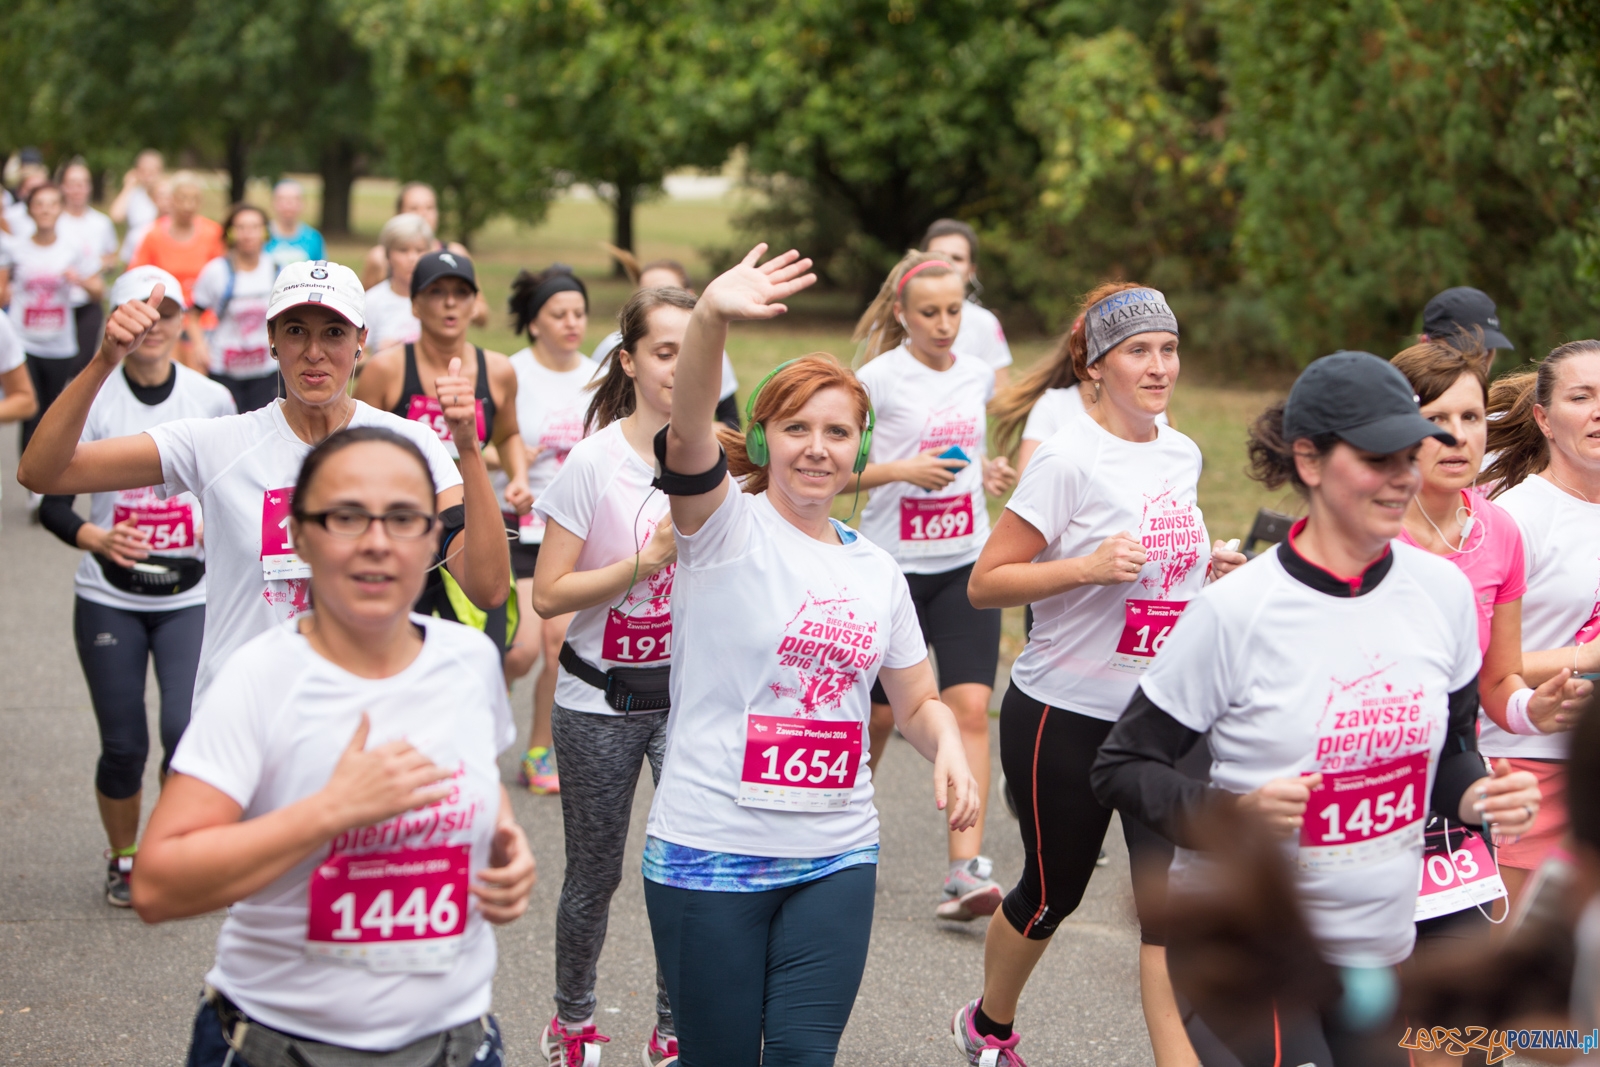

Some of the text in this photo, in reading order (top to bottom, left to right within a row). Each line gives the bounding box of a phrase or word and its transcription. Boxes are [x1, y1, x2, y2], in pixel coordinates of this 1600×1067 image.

[1099, 291, 1155, 317] LESZNO
[910, 511, 969, 539] 1699
[1150, 514, 1195, 531] zawsze
[1146, 549, 1168, 562] 2016
[799, 620, 873, 650] zawsze
[826, 617, 866, 633] BIEG KOBIET
[779, 653, 813, 670] 2016
[1334, 704, 1420, 730] zawsze
[776, 726, 803, 737] Zawsze
[832, 731, 848, 740] 2016
[760, 745, 850, 784] 1654
[1319, 783, 1416, 842] 1454
[330, 882, 460, 940] 1446
